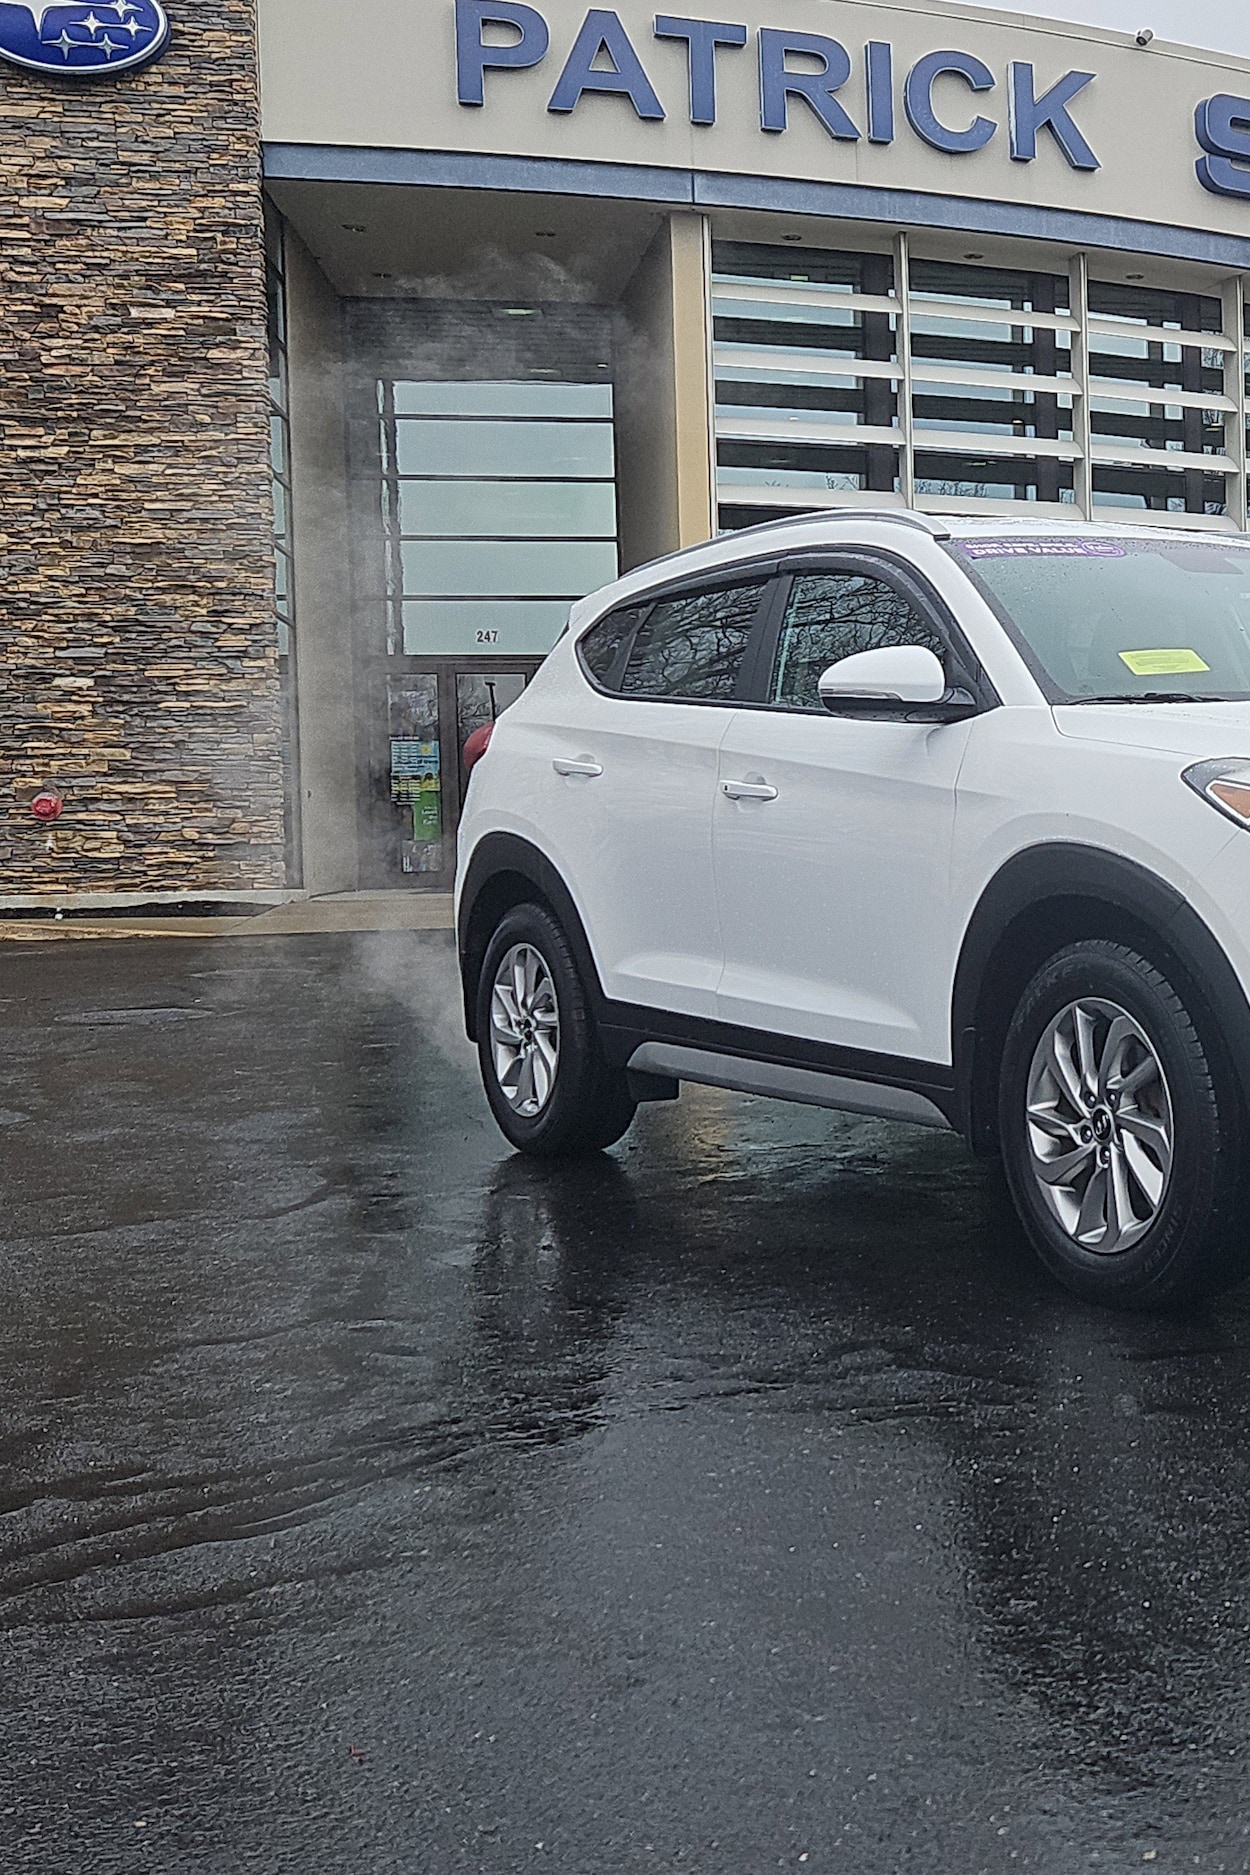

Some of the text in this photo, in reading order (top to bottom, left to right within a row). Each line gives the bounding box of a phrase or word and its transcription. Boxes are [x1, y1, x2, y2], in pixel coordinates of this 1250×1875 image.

[454, 0, 1102, 172] PATRICK
[972, 547, 1028, 555] DRIVE
[1028, 547, 1087, 555] VALUE
[476, 630, 498, 643] 247
